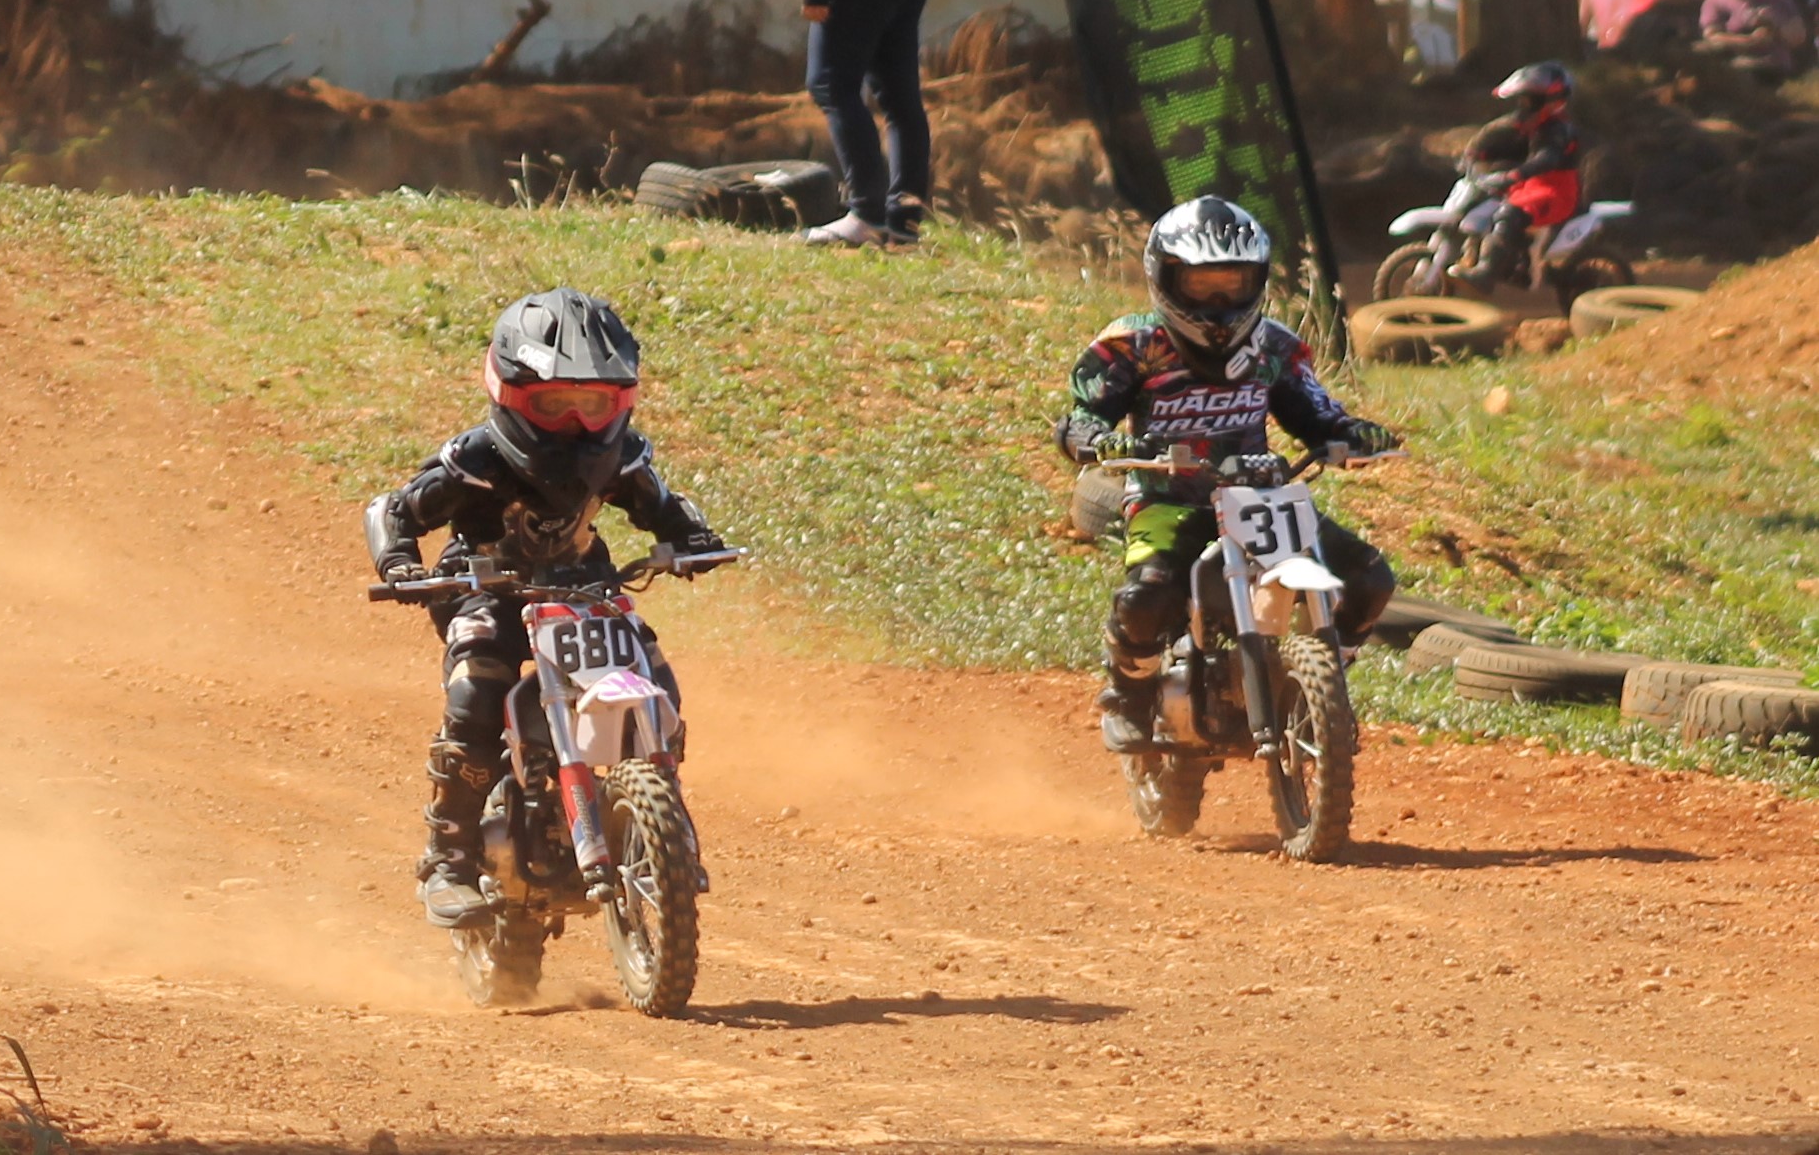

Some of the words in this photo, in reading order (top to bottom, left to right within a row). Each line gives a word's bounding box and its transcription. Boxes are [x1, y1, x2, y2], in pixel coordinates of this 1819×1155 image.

[1147, 409, 1265, 432] RACING
[1239, 501, 1302, 556] 31
[553, 617, 636, 674] 680
